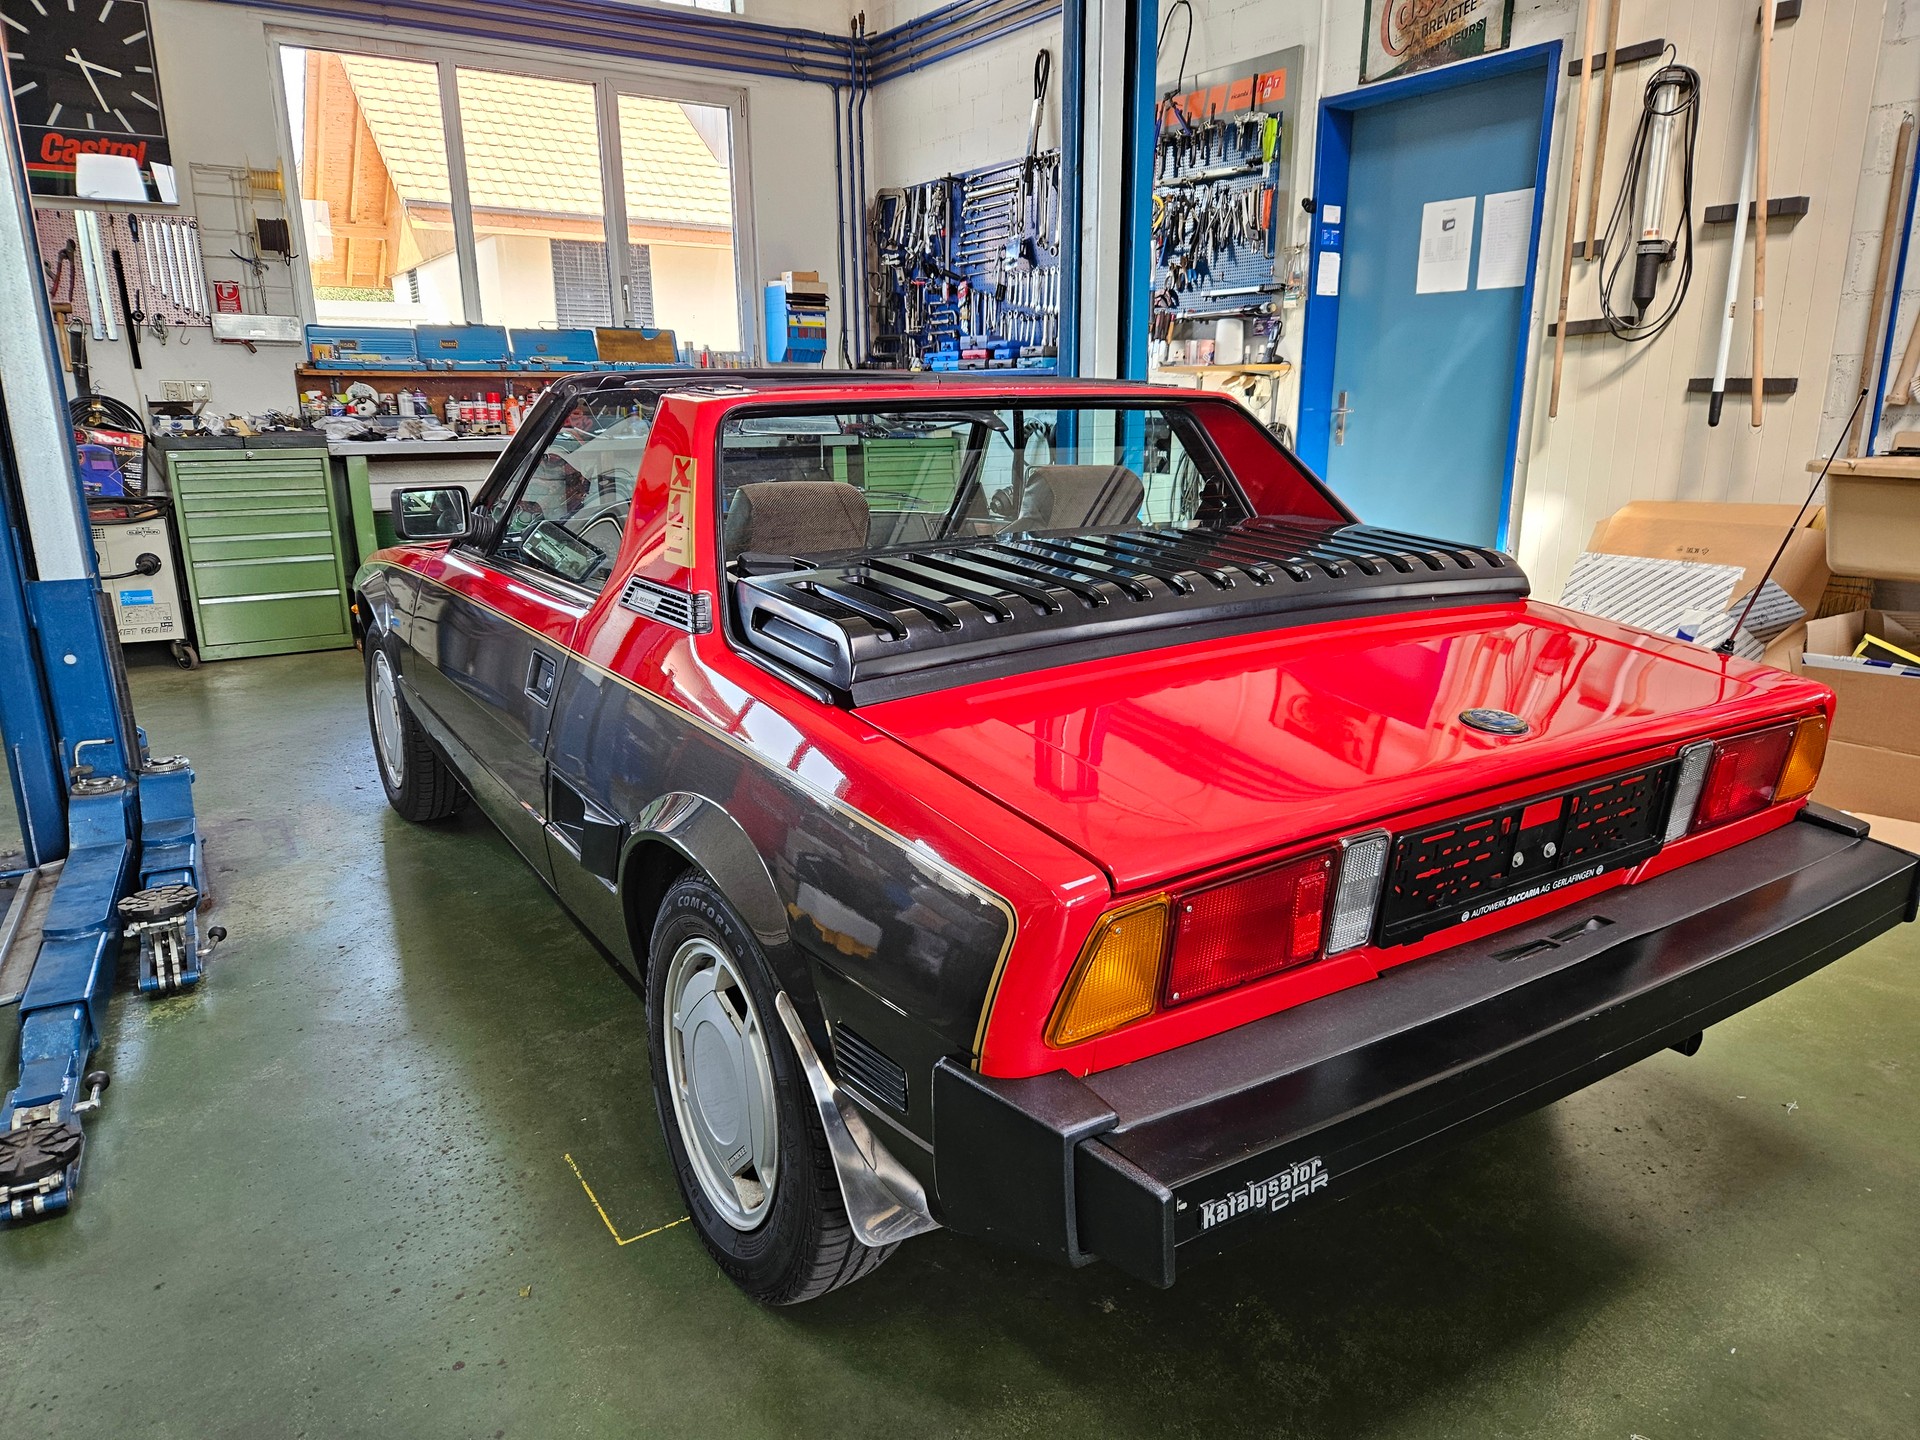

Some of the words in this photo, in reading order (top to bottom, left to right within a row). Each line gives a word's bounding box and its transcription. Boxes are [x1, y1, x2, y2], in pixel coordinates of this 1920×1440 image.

[1471, 900, 1506, 918] AUTOWERK
[1506, 887, 1540, 906] ZACCARIA
[1540, 883, 1550, 893] AG
[1552, 869, 1595, 889] GERLAFINGEN
[677, 896, 733, 937] COMFORT
[1201, 1157, 1322, 1229] Katalysator
[1271, 1171, 1328, 1212] CAR
